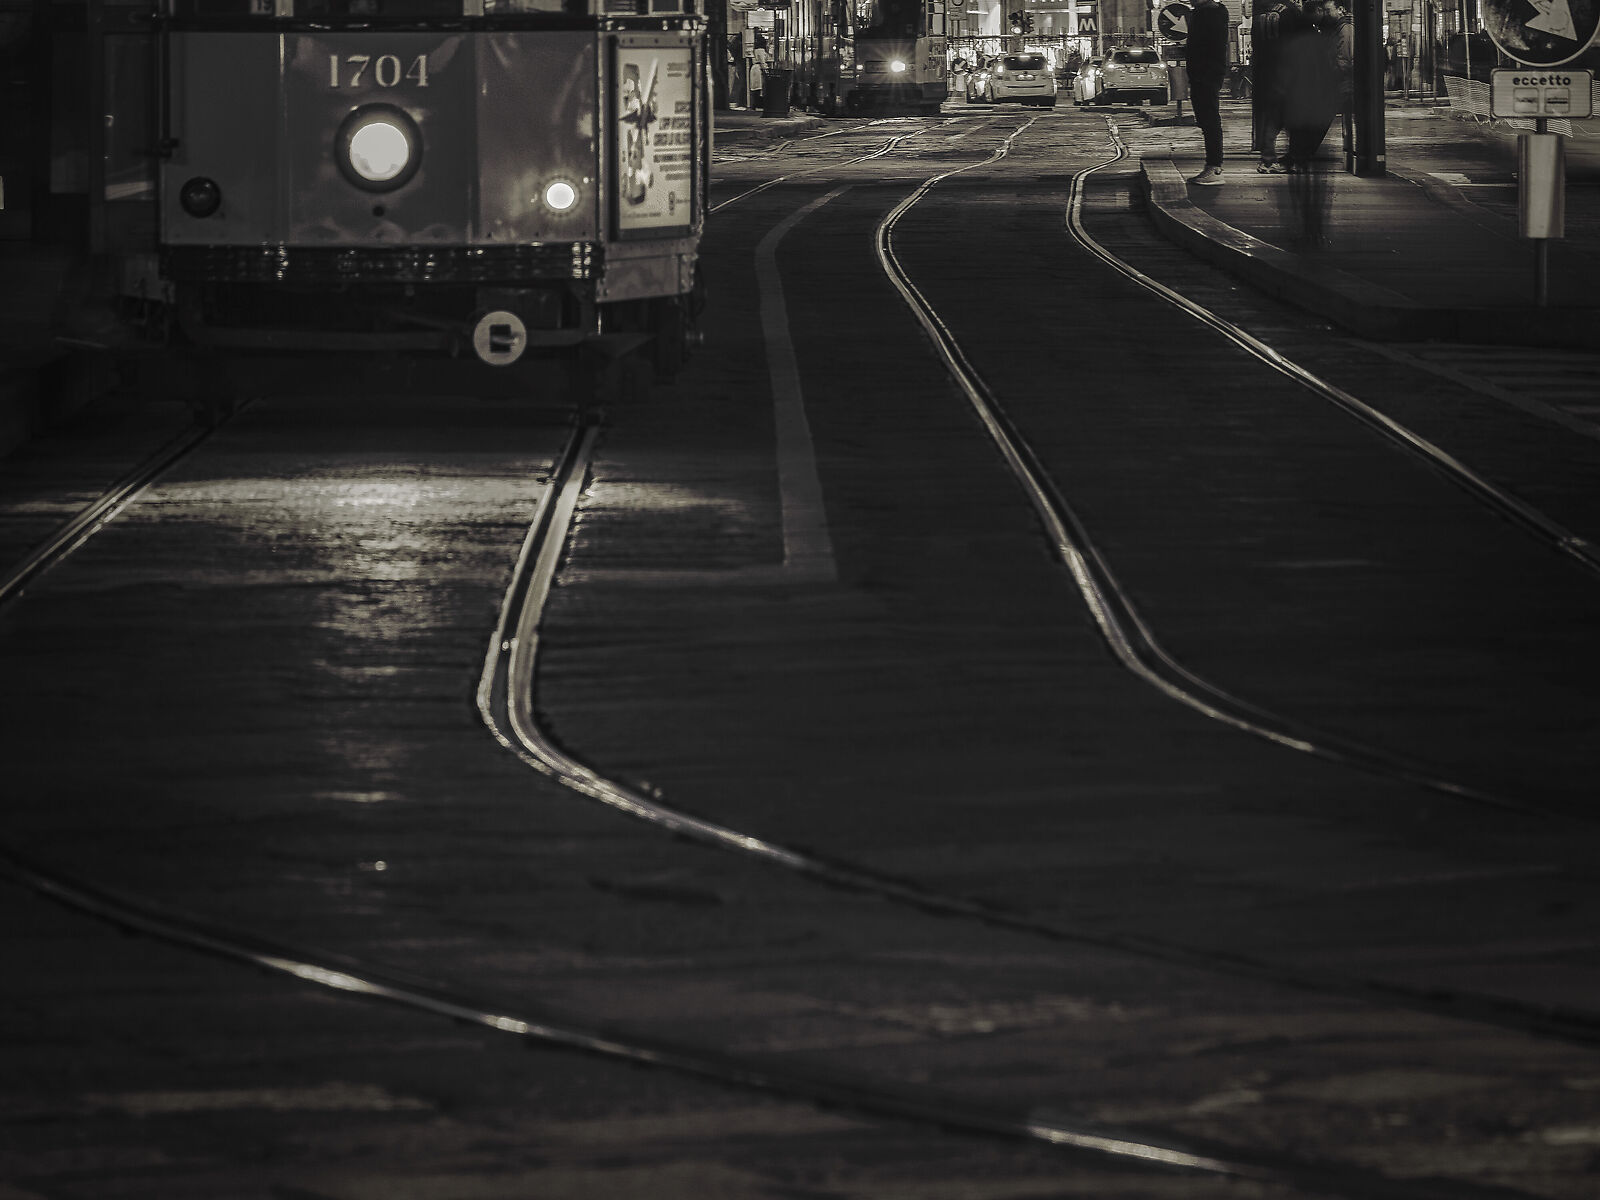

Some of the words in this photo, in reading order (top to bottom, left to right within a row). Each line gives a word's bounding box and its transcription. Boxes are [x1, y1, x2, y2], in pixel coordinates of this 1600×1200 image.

[1079, 18, 1097, 31] M
[328, 54, 429, 87] 1704
[1513, 75, 1571, 86] eccetto
